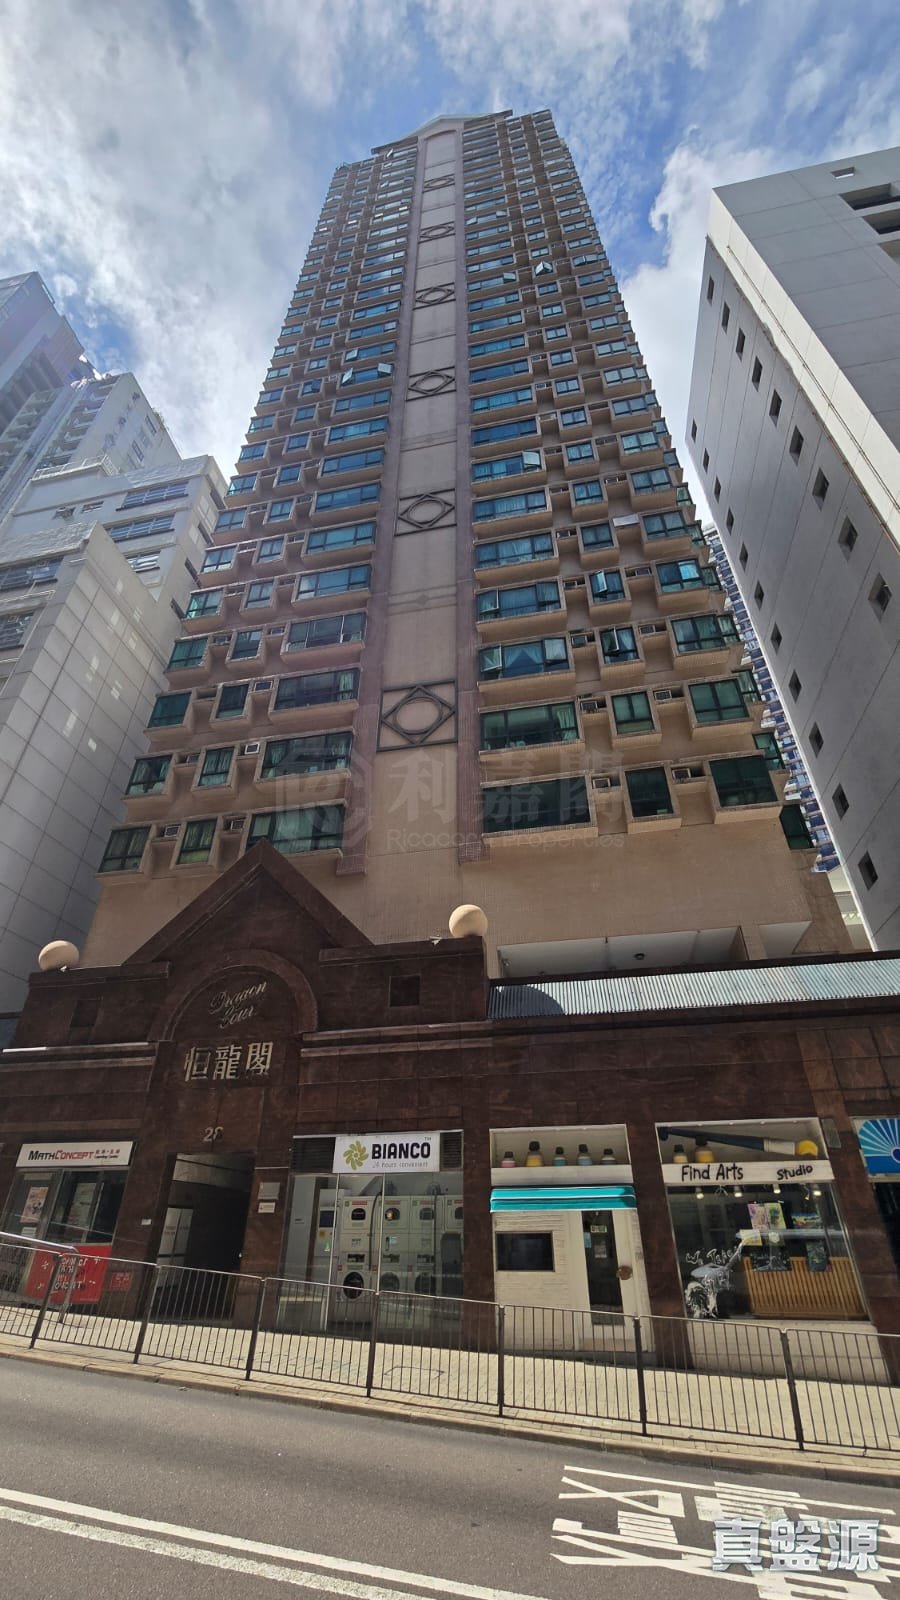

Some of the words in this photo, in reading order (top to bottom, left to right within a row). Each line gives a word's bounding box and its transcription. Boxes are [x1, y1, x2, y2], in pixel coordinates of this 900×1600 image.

[184, 1042, 274, 1082] 恒龍閣
[371, 1142, 431, 1160] BIANCO
[681, 1164, 711, 1182] Find
[716, 1162, 744, 1181] Arts
[776, 1164, 813, 1181] Studio
